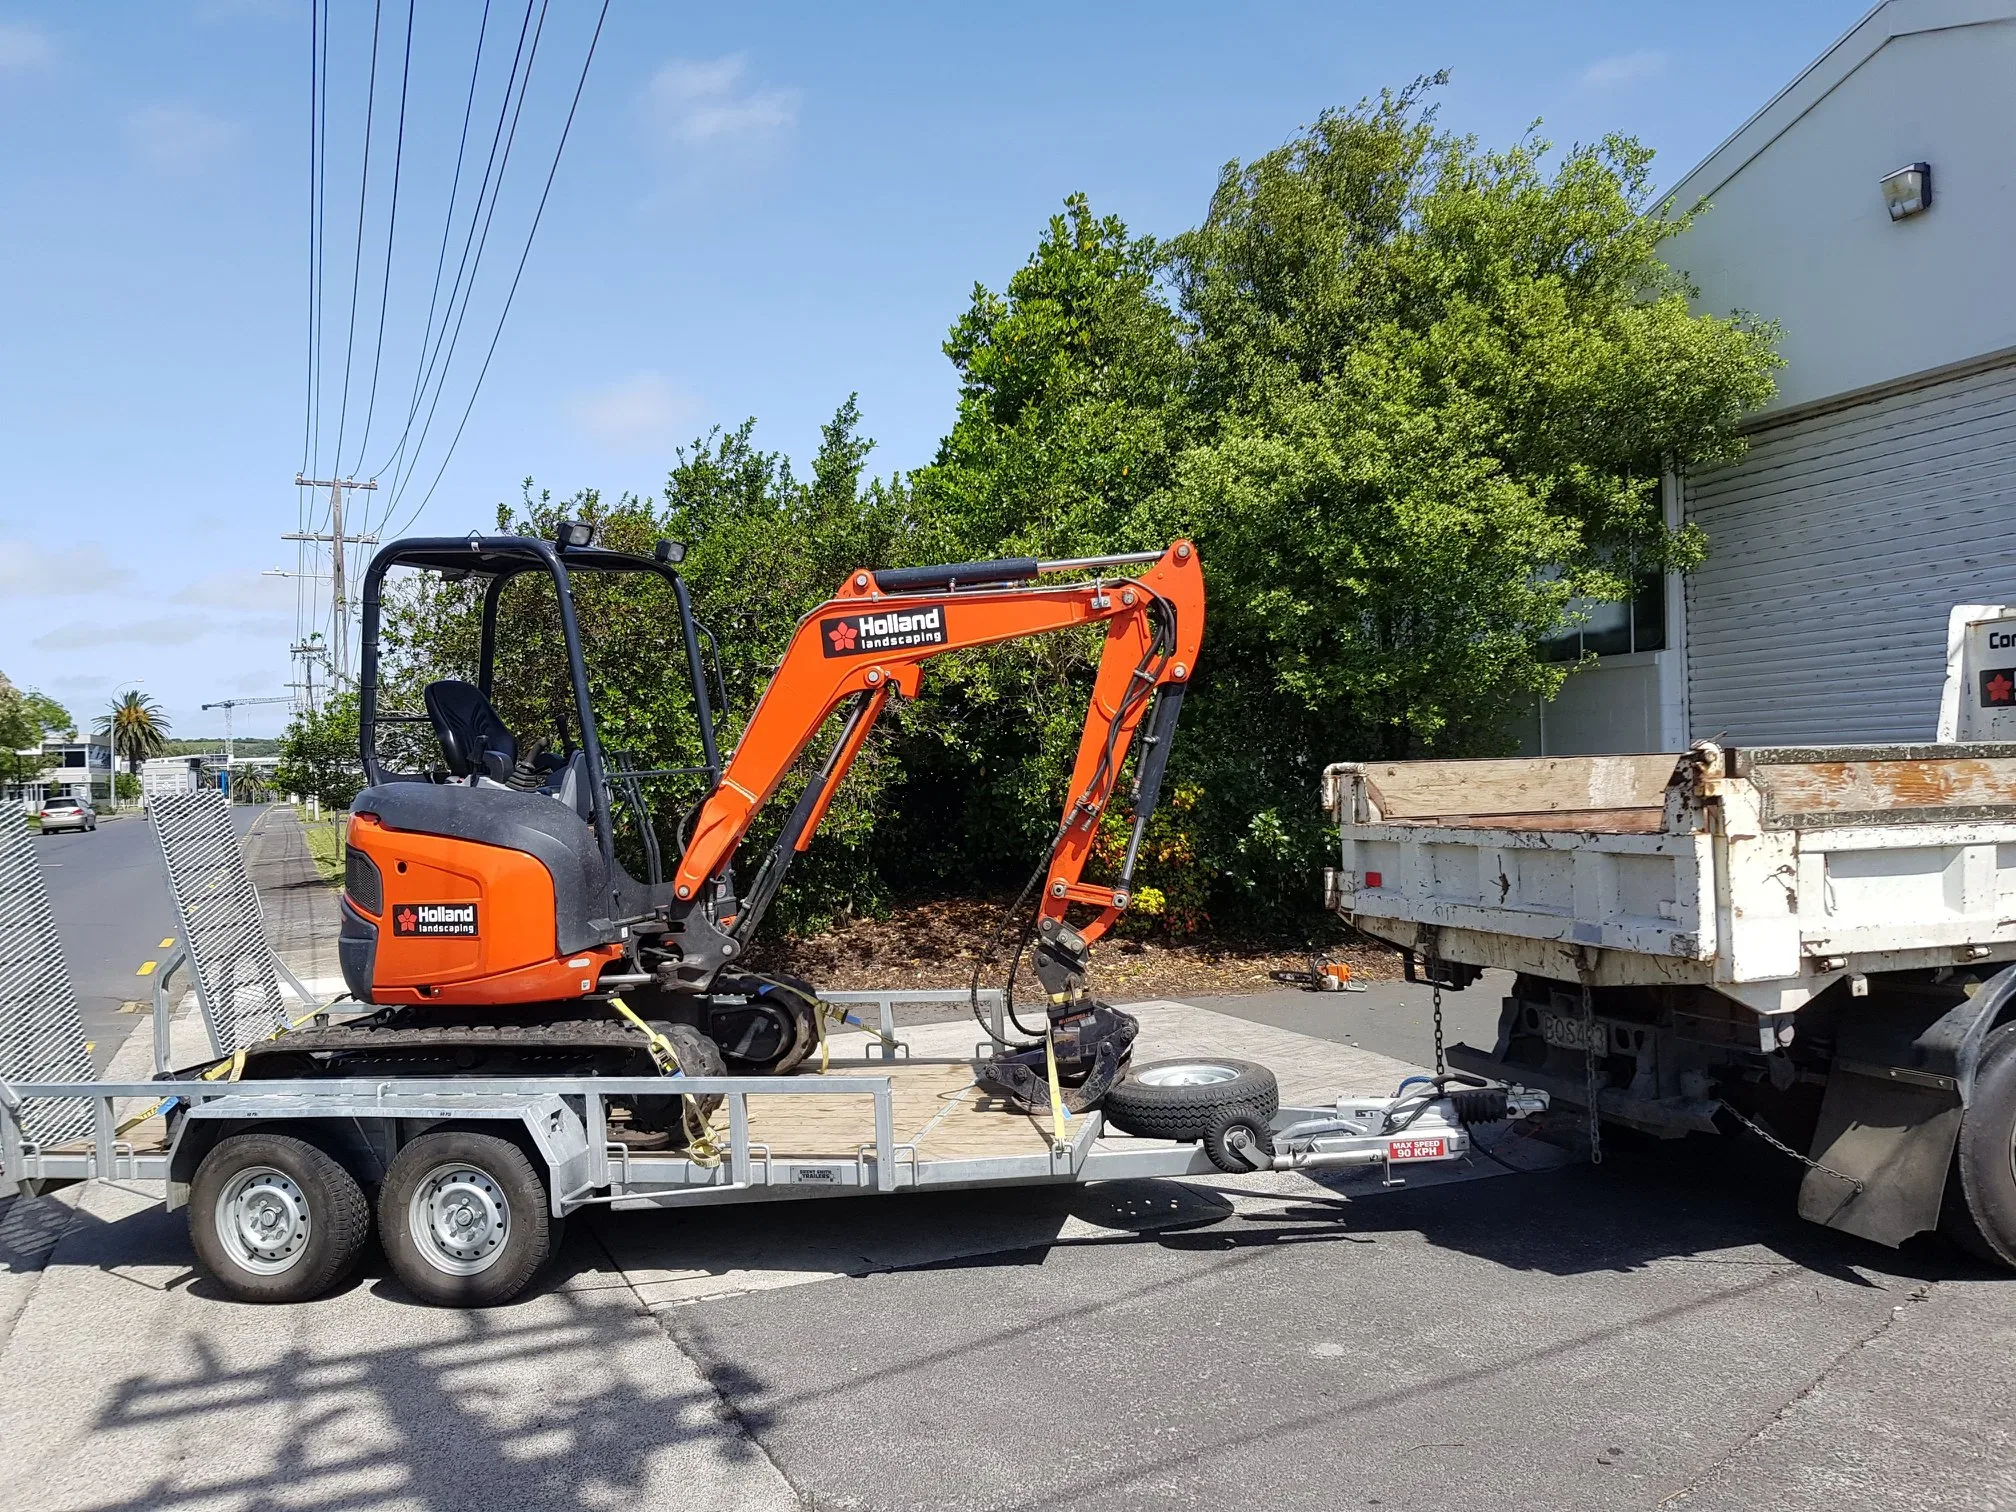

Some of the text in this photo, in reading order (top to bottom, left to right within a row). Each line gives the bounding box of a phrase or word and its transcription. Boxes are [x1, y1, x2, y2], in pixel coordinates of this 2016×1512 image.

[859, 609, 940, 637] Holland
[862, 632, 942, 649] landscaping
[418, 906, 474, 922] Holland
[419, 924, 475, 934] landscaping
[1414, 1140, 1440, 1148] SPEED
[1397, 1147, 1437, 1157] 90 KPH
